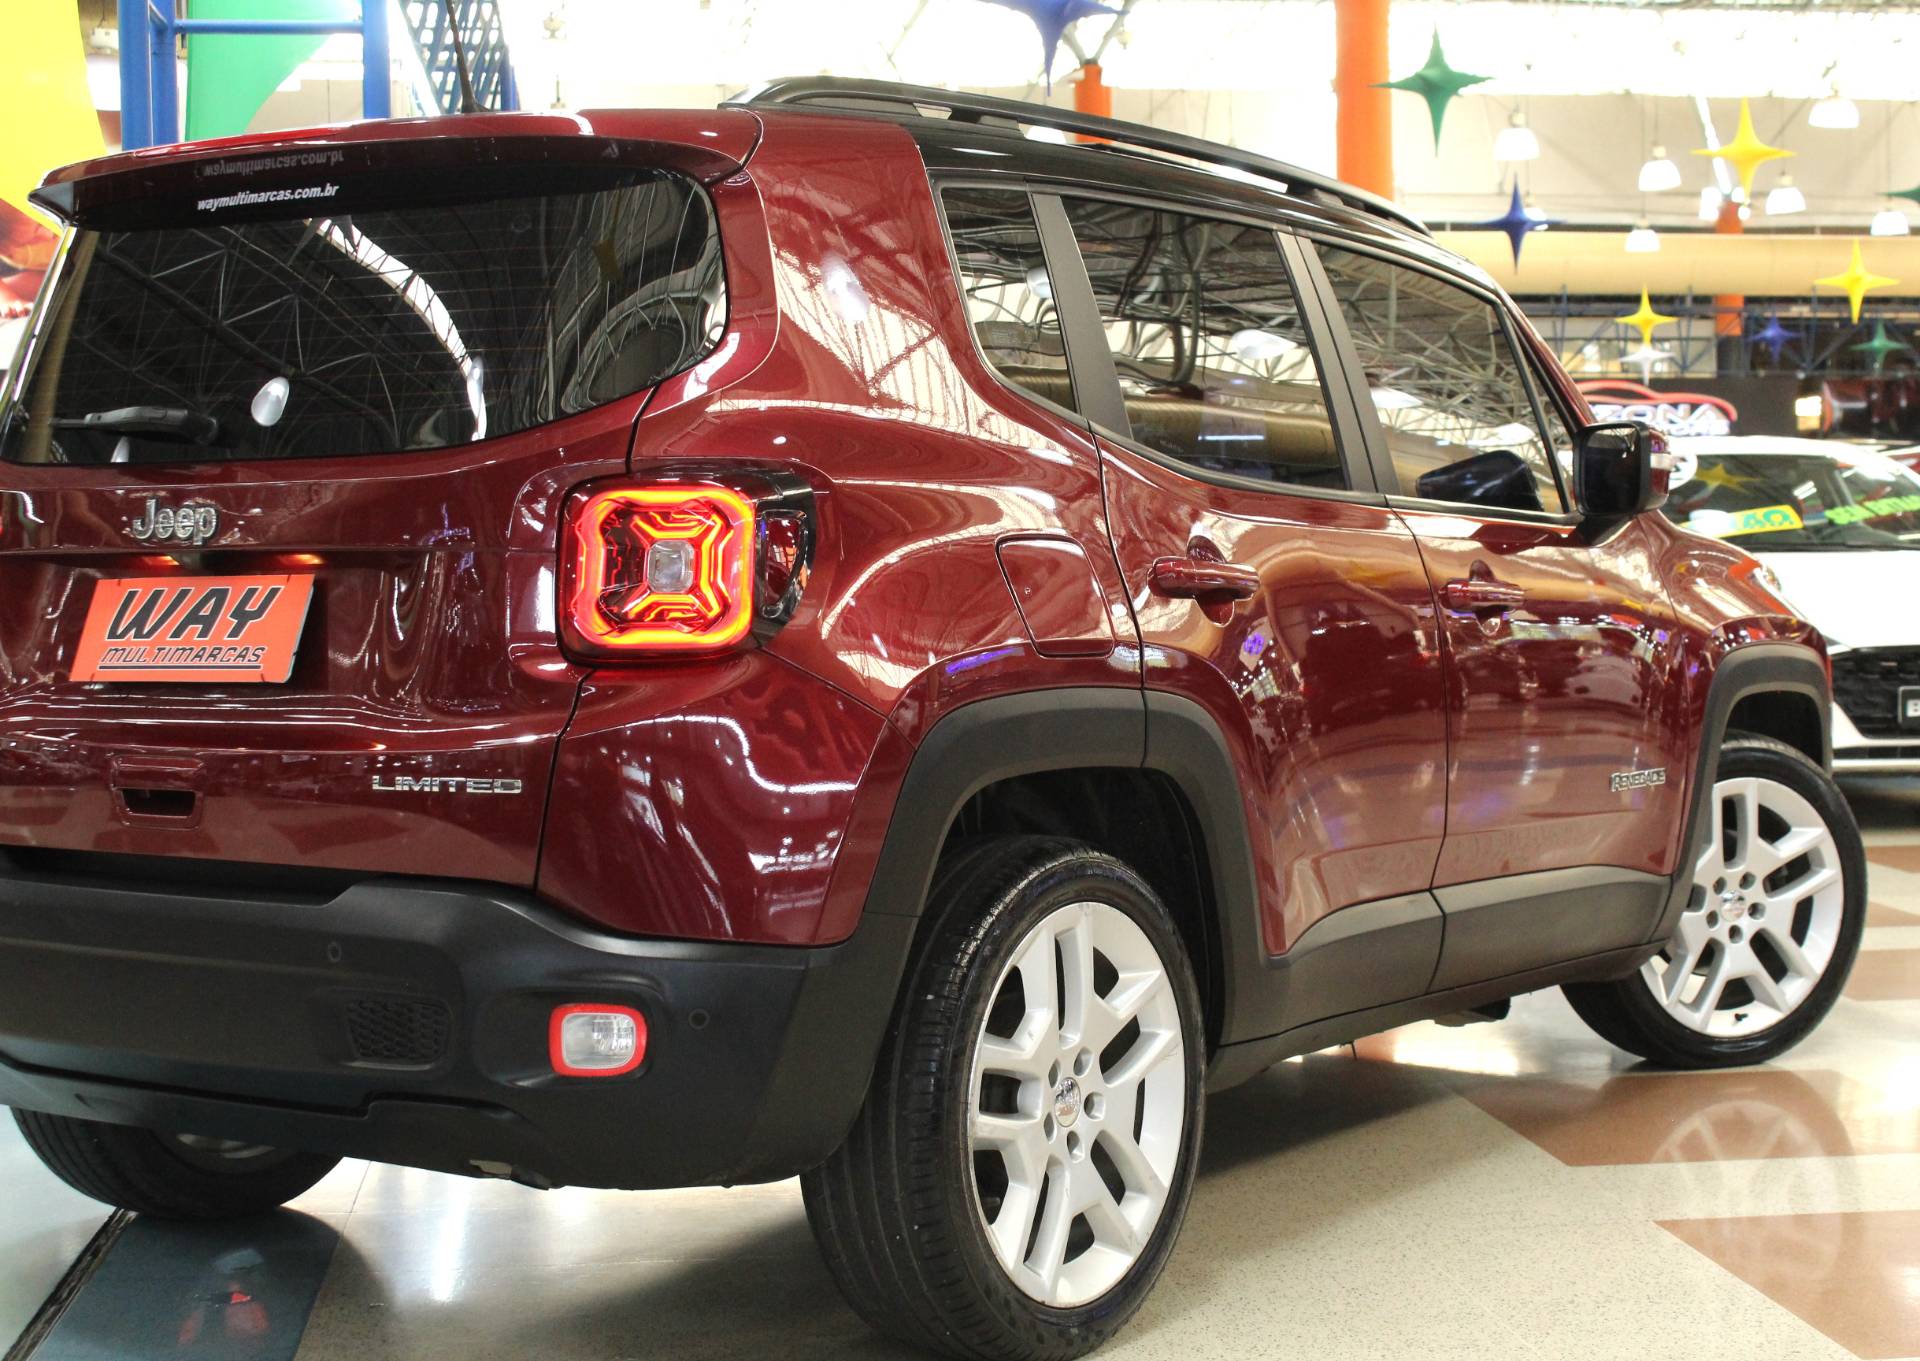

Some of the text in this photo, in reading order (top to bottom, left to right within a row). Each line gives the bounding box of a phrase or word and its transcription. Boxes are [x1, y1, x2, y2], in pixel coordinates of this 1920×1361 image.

[197, 183, 339, 211] waymultimarcas.com.br
[132, 499, 218, 545] Jeep
[104, 586, 285, 641] WAY
[100, 646, 267, 663] MULTIMARCAS
[372, 775, 522, 794] LIMITED
[1611, 767, 1666, 792] RENEGADE
